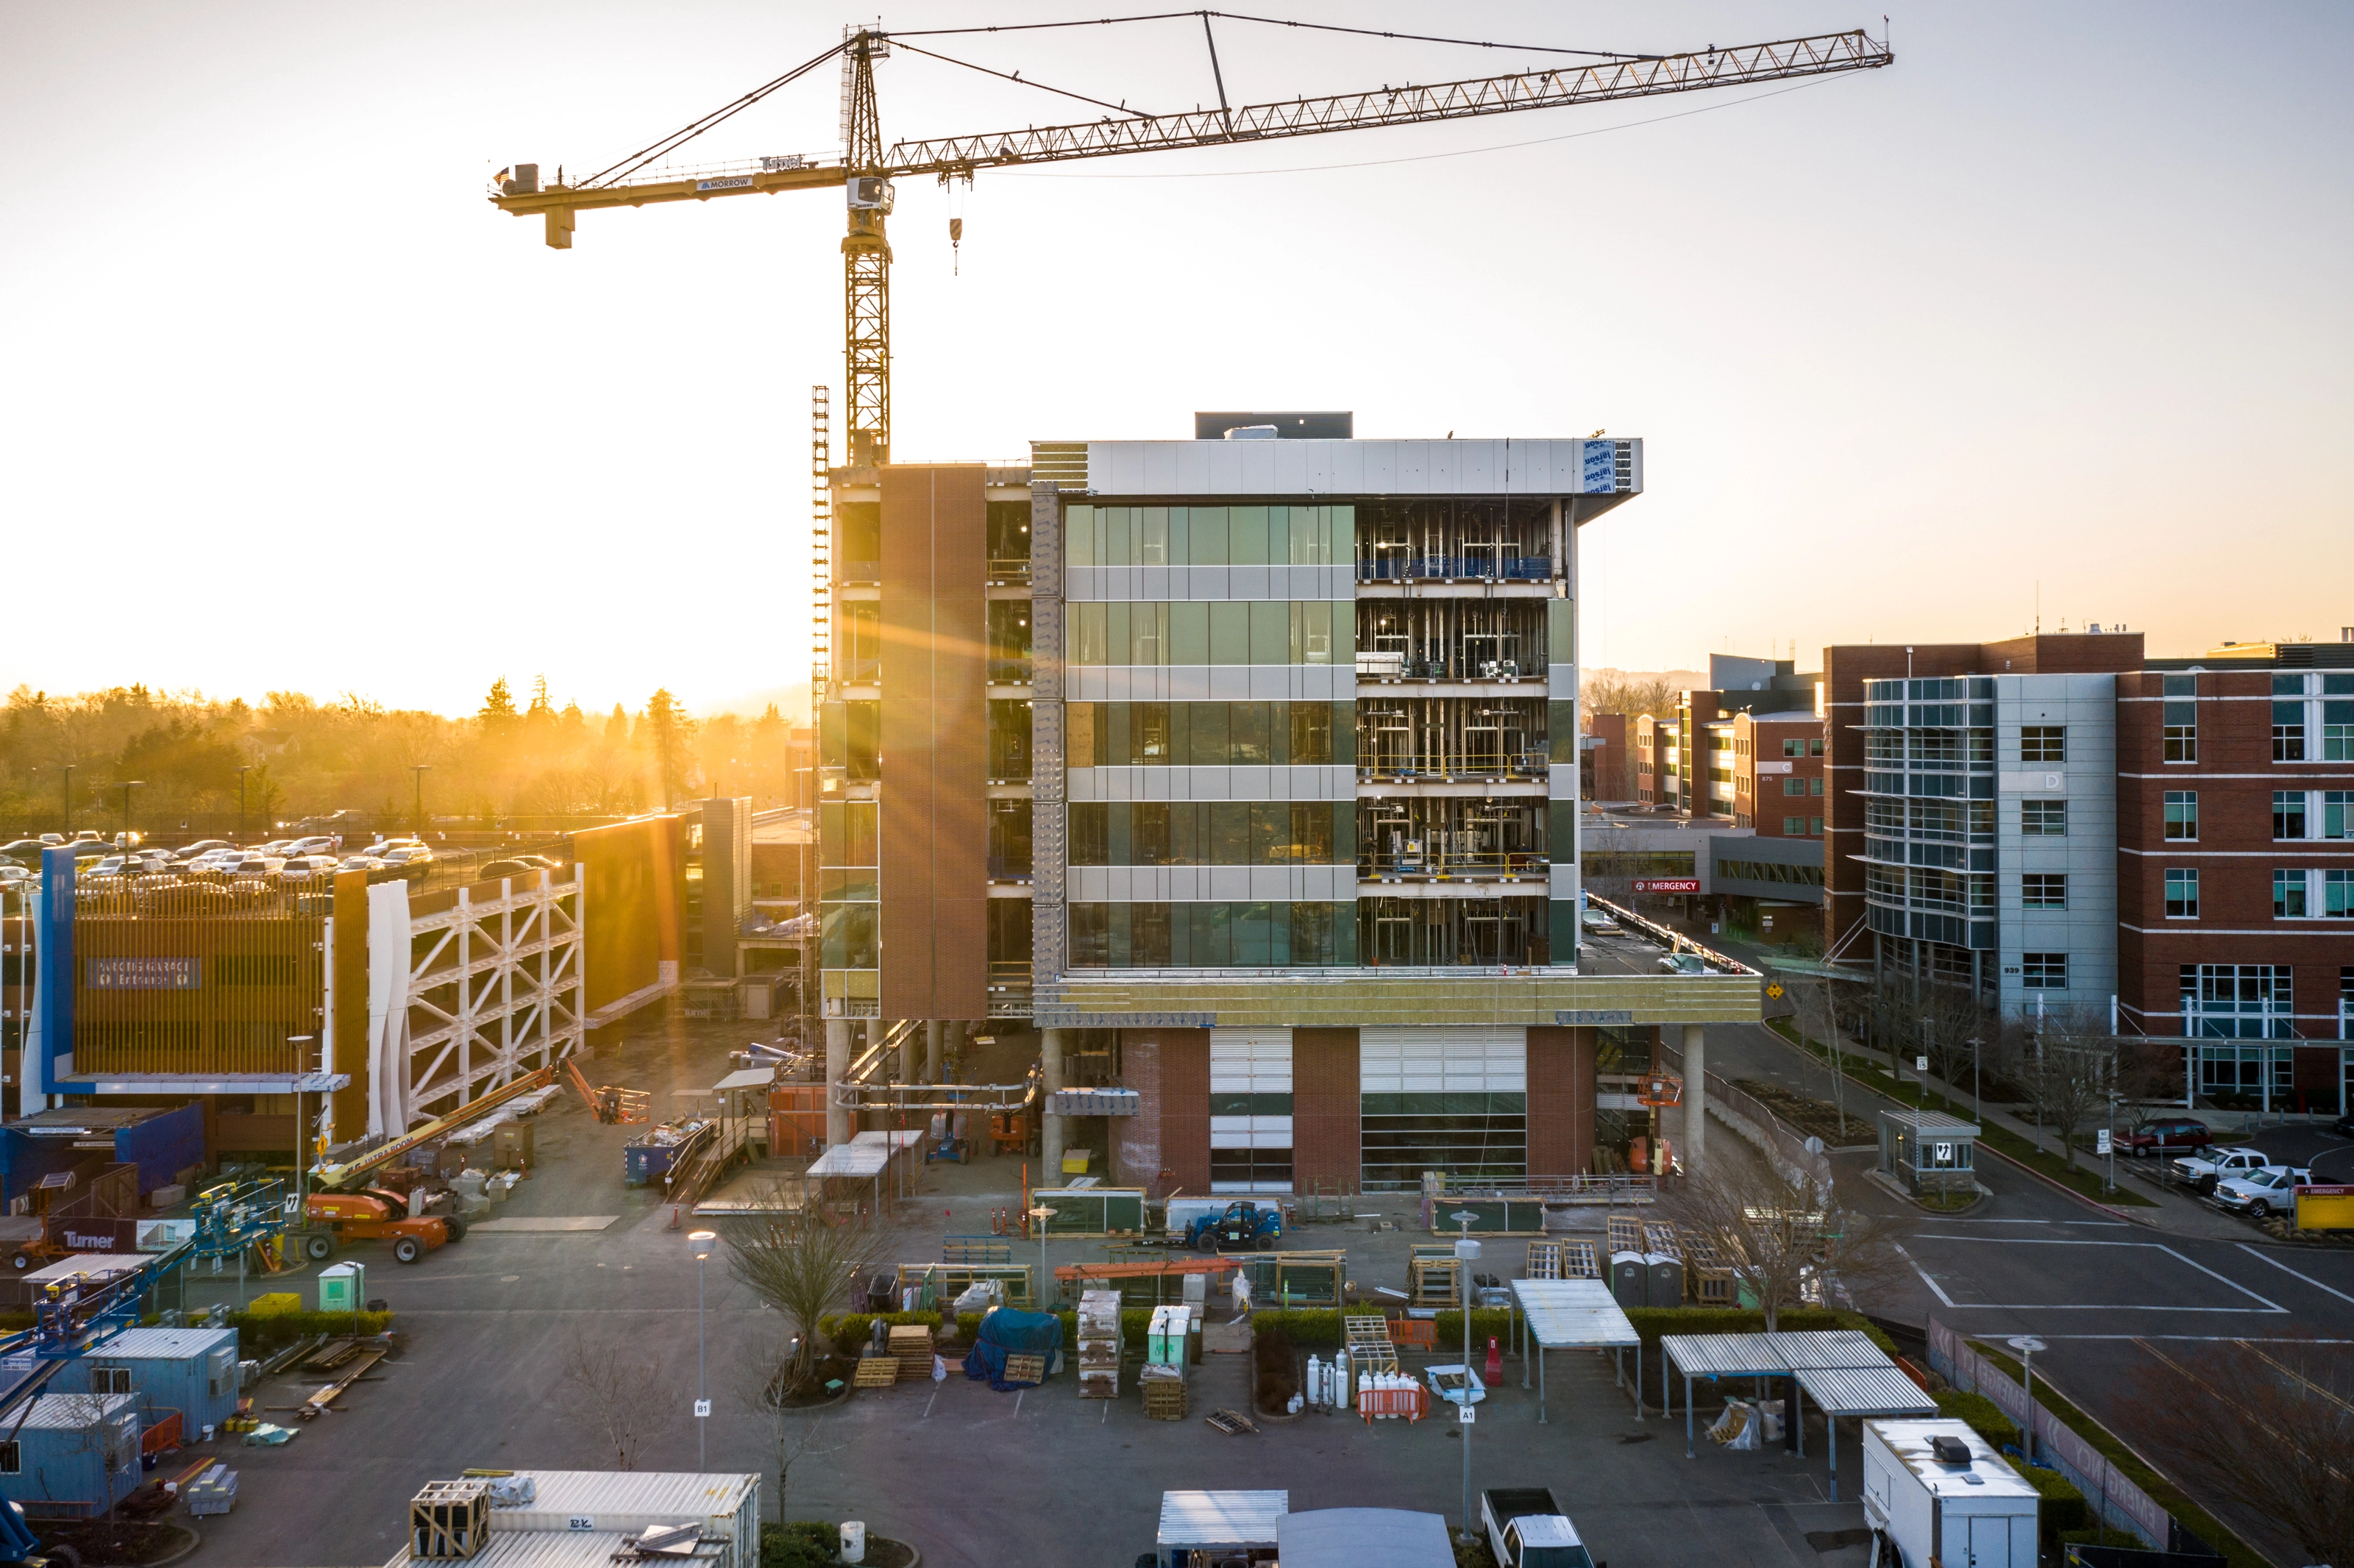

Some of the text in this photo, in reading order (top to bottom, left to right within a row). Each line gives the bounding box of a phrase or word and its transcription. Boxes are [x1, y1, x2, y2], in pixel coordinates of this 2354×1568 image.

[760, 156, 803, 170] Turner
[710, 177, 749, 188] MORROW
[1585, 451, 1611, 465] larson
[1585, 467, 1611, 481] larson
[1782, 763, 1791, 772] C
[2045, 774, 2060, 788] D
[390, 1136, 413, 1152] BOOM
[63, 1230, 115, 1249] Turner
[697, 1405, 707, 1413] B1
[1462, 1411, 1473, 1419] A1
